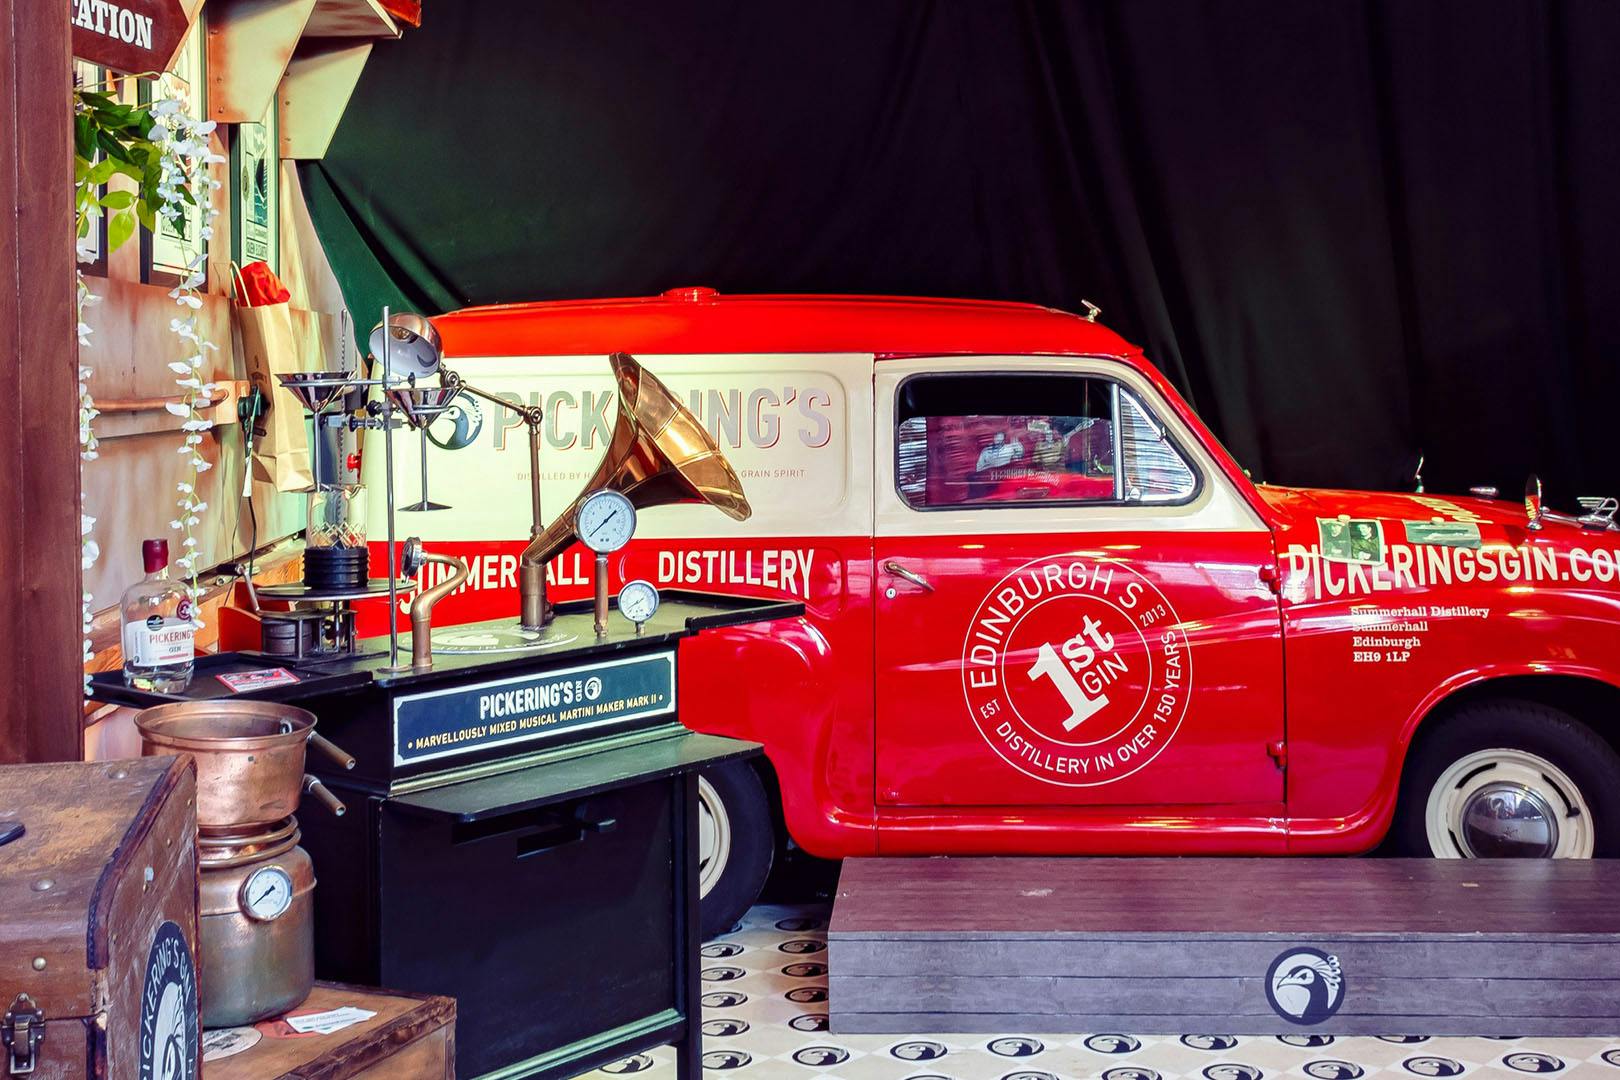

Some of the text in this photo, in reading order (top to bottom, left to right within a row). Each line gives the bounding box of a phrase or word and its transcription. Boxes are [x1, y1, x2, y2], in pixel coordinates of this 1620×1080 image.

[71, 0, 153, 50] ATION
[741, 469, 771, 478] GRAIN
[773, 469, 805, 478] SPIRIT
[658, 549, 814, 600] DISTILLERY
[1287, 542, 1620, 603] PICKERINGSGIN.CO
[1139, 603, 1167, 628] 2013
[1350, 606, 1489, 619] Summerhall Distillery
[1352, 621, 1428, 632] Summerhall
[1352, 636, 1421, 649] Edinburgh
[1353, 651, 1410, 662] EH9 1LP
[575, 680, 583, 702] GIN
[1026, 614, 1115, 733] 1st
[1081, 651, 1129, 695] GIN
[479, 680, 573, 720] PICKERING'S
[979, 699, 1001, 719] EST
[995, 630, 1183, 774] DISTILLERY IN OVER 150 YEARS
[415, 726, 488, 749] MARVELLOUSLY
[489, 720, 517, 736] MIXED
[519, 713, 557, 729] MUSICAL
[559, 706, 594, 722] MARTINI
[596, 700, 625, 715] MAKER
[626, 696, 649, 709] MARK
[141, 936, 180, 1080] ICKERING'S
